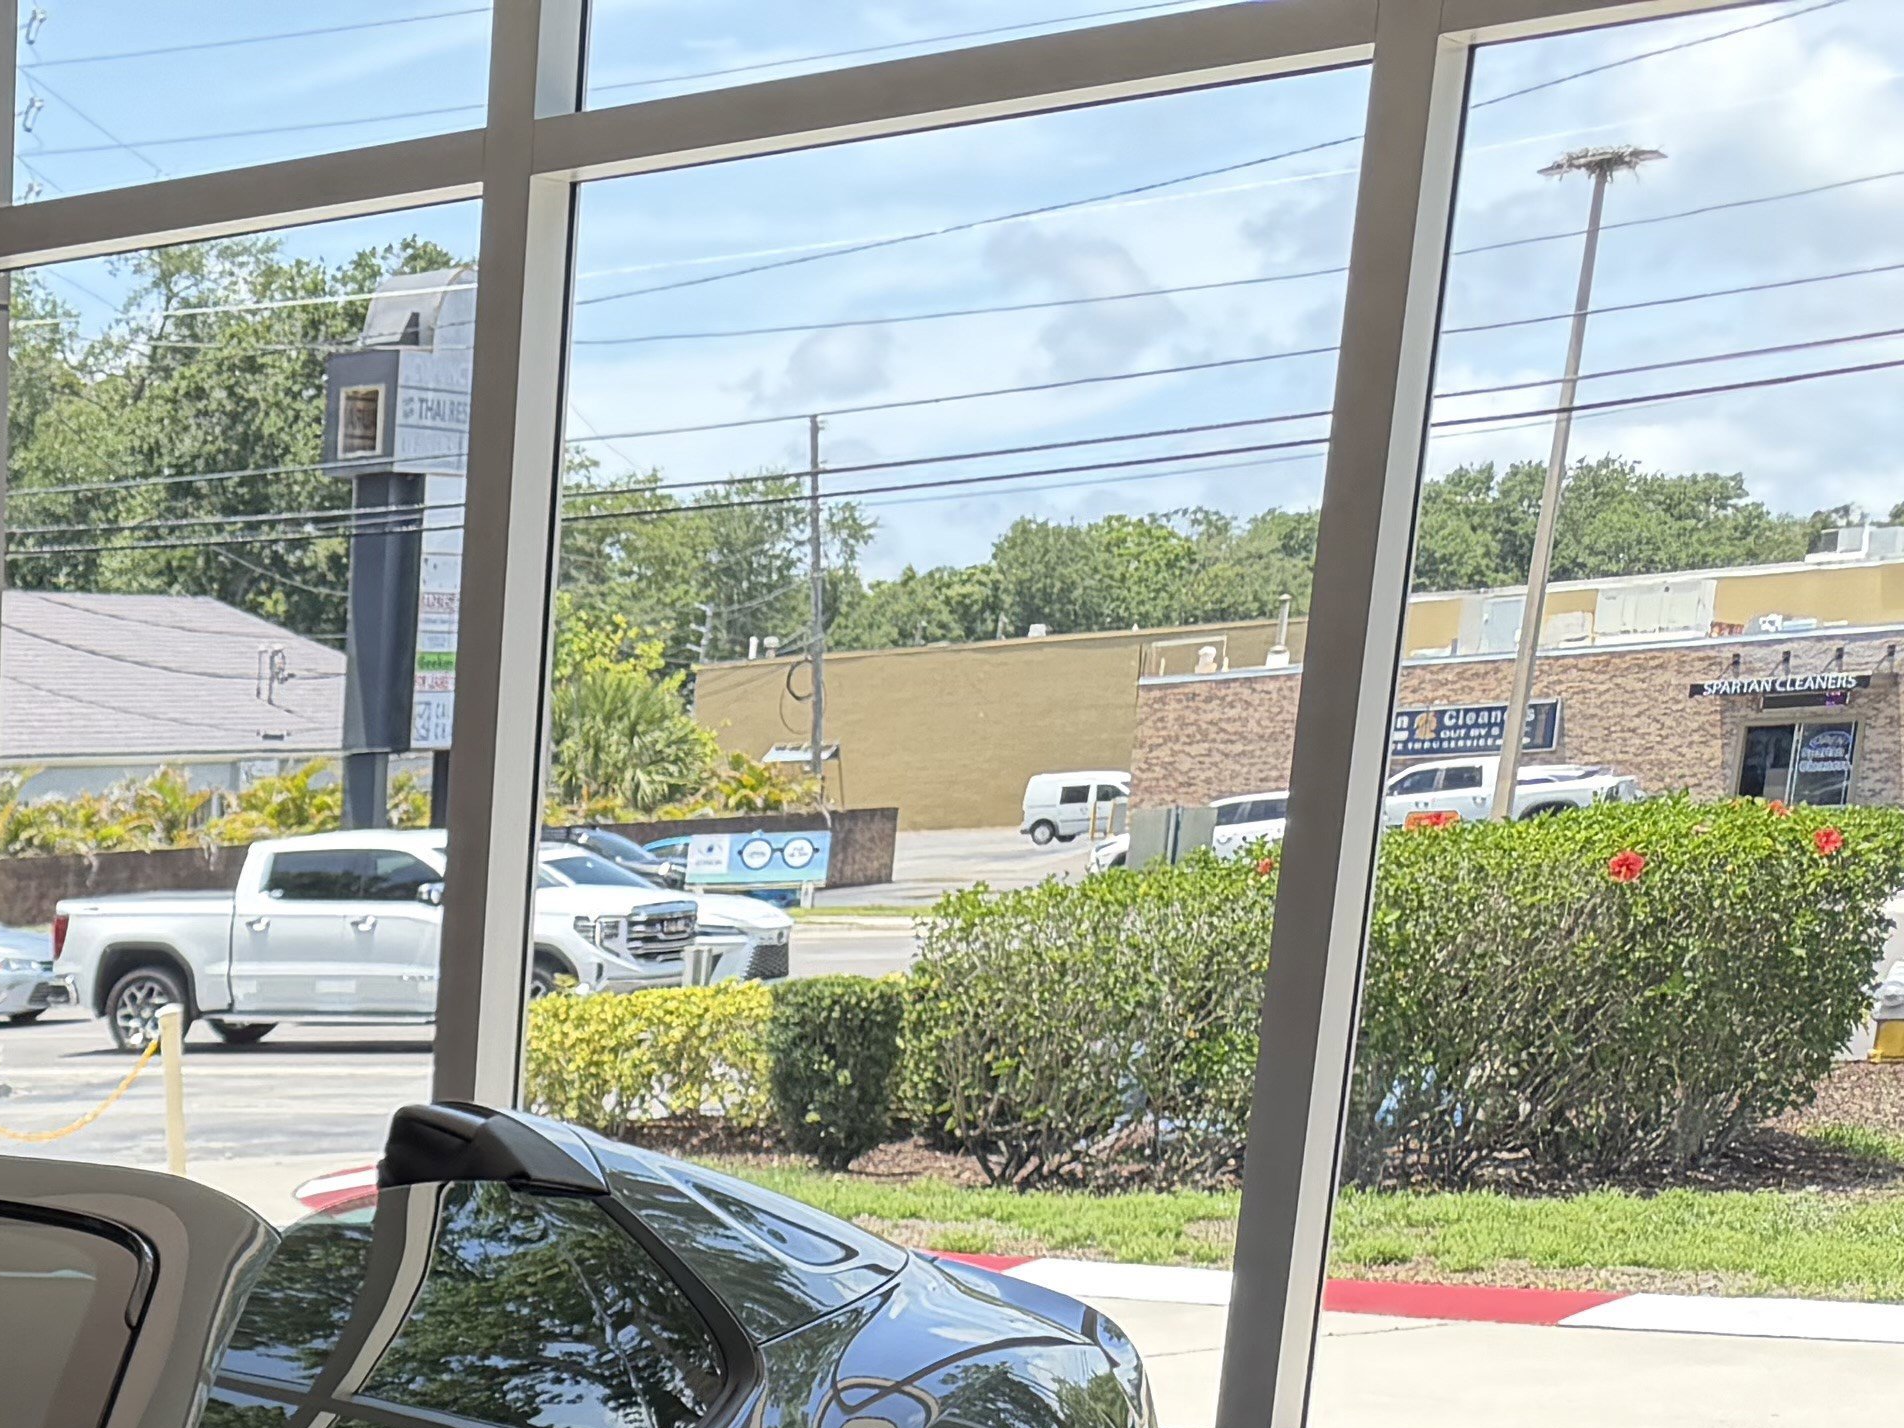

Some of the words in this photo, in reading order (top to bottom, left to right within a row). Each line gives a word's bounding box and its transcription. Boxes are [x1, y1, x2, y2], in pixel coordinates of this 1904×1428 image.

[1702, 679, 1773, 697] SPARTAN
[1775, 674, 1858, 692] CLEANERS
[1443, 708, 1536, 727] Cleans
